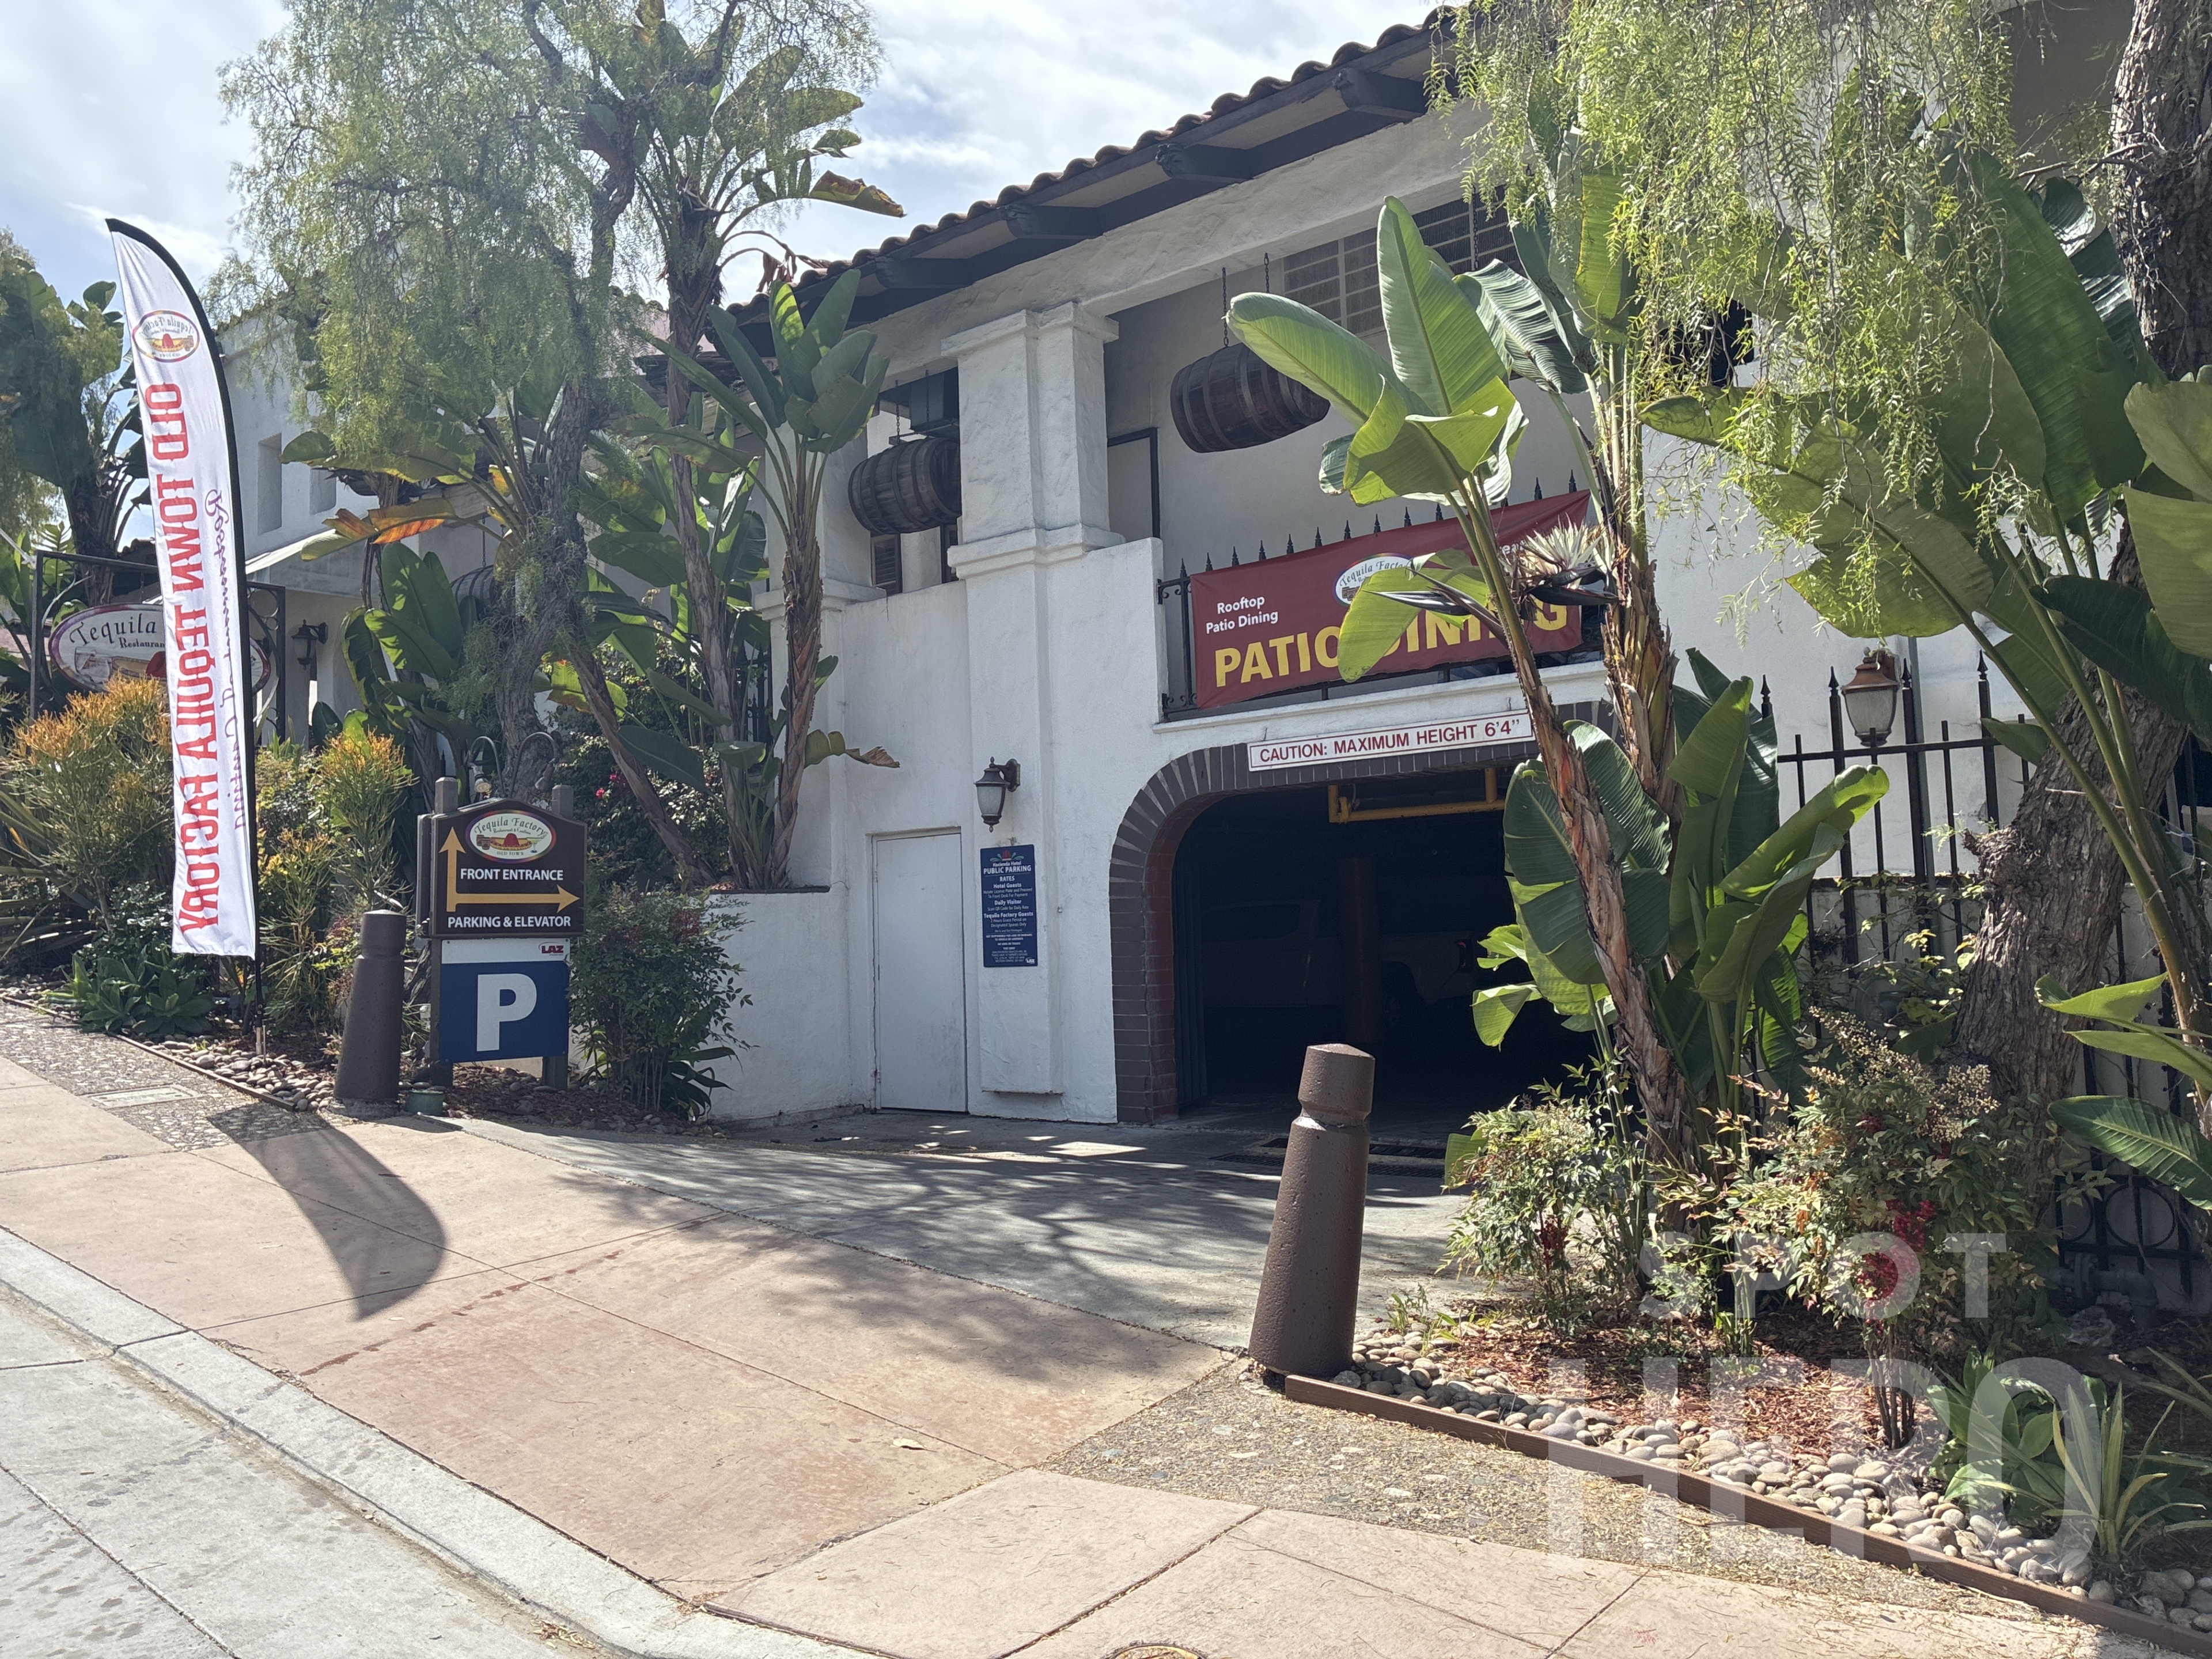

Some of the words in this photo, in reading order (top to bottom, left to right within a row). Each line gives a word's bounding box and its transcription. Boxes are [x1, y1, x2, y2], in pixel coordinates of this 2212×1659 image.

[1339, 563, 1373, 586] Tequila
[1376, 560, 1404, 570] Facto
[1217, 596, 1265, 615] Rooftop
[69, 613, 157, 645] Tequila
[1206, 619, 1235, 634] Patio
[1238, 611, 1279, 628] Dining
[119, 637, 165, 649] Restauran
[1215, 626, 1340, 687] PATIO
[1260, 742, 1327, 763] CAUTION:
[1334, 733, 1410, 755] MAXIMUM
[1416, 724, 1477, 745] HEIGHT
[474, 816, 509, 834] Tequila
[512, 817, 546, 836] Factory
[460, 868, 500, 880] FRONT
[502, 869, 563, 881] ENTRANCE
[448, 916, 501, 928] PARKING
[503, 916, 513, 927] &
[515, 916, 571, 927] ELEVATOR
[541, 945, 563, 953] LAZ
[476, 974, 537, 1052] P
